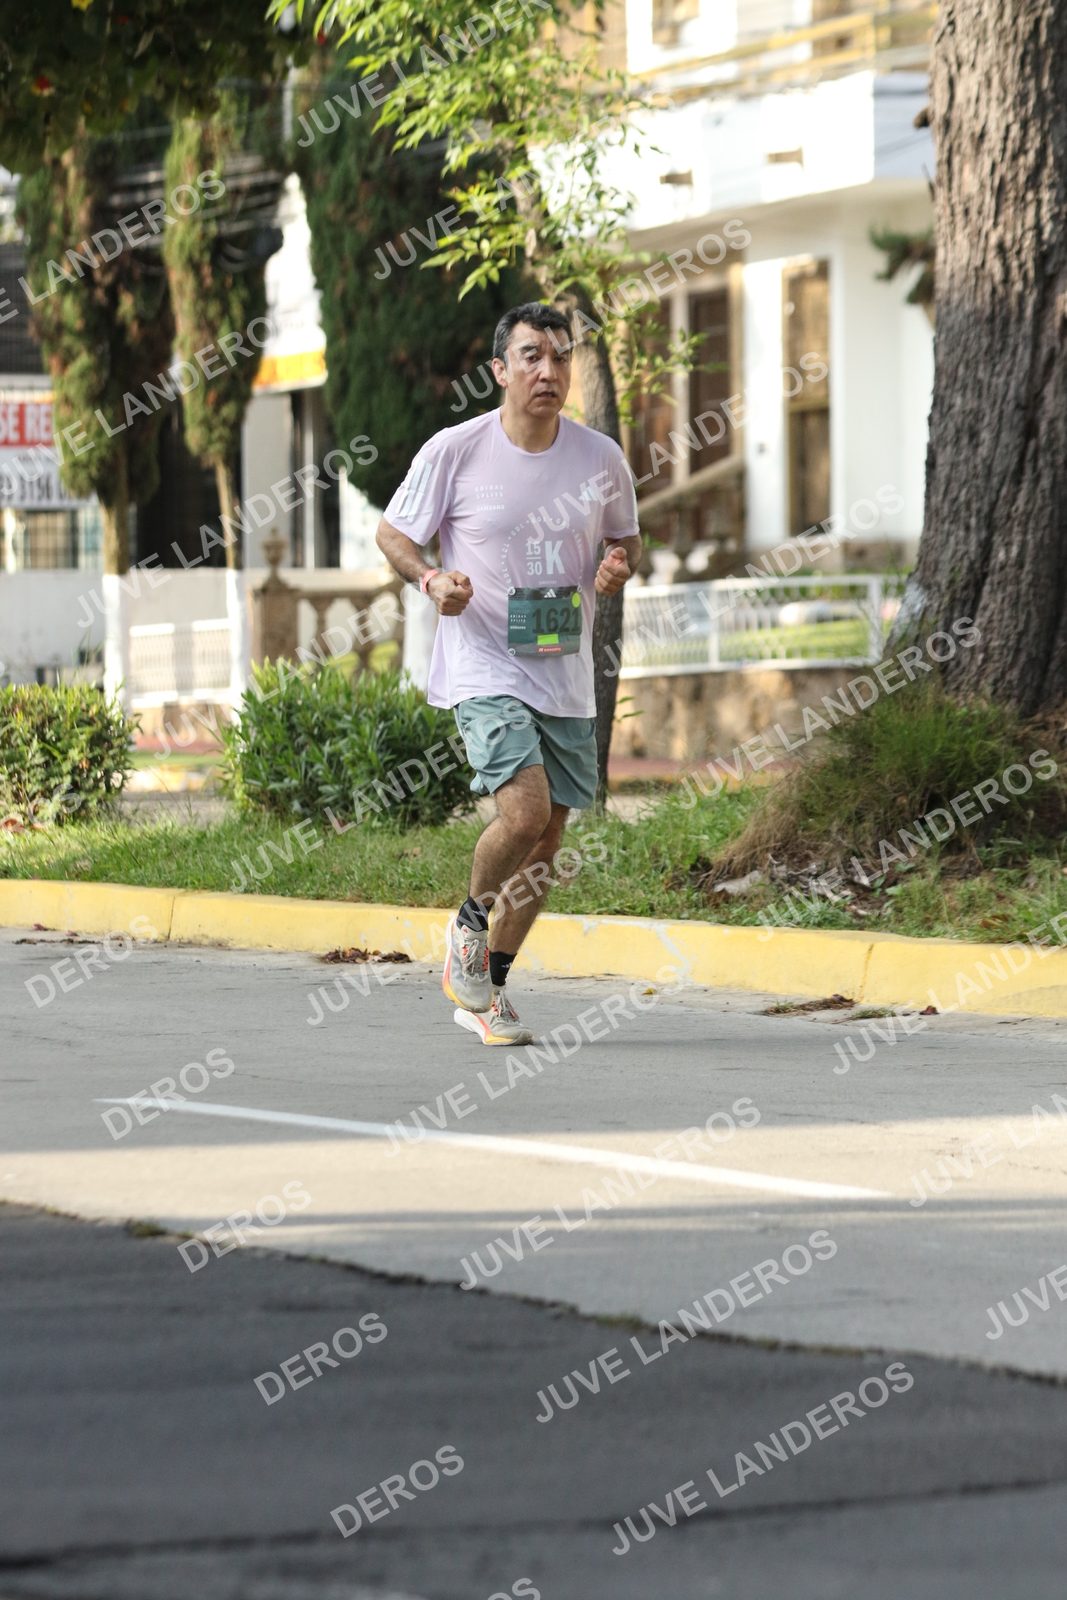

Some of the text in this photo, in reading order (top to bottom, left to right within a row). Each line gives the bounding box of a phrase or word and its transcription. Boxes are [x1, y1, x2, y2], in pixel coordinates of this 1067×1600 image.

[526, 540, 541, 556] 15
[545, 540, 565, 575] K
[527, 561, 543, 576] 30
[532, 607, 580, 635] 1621
